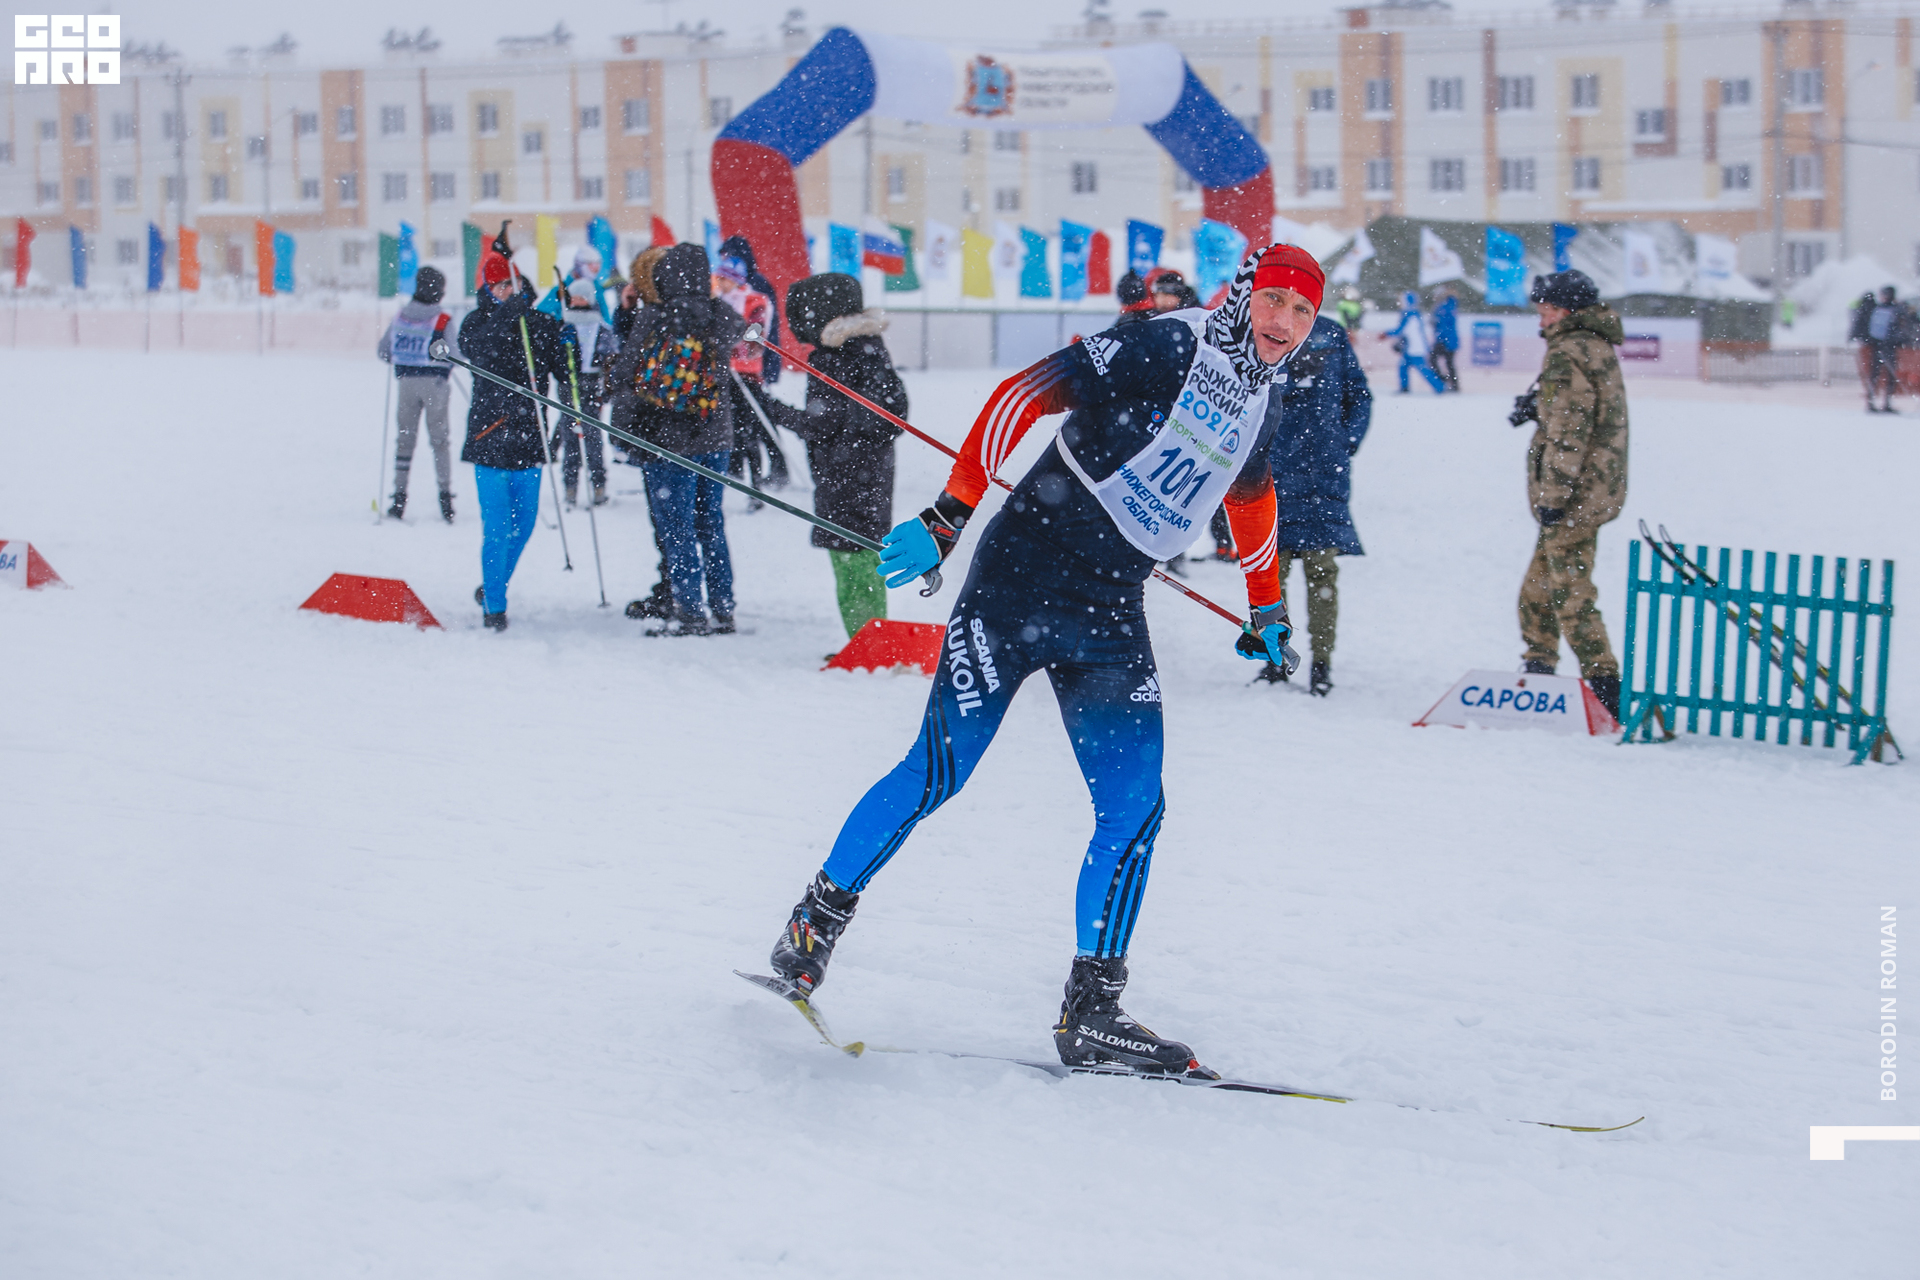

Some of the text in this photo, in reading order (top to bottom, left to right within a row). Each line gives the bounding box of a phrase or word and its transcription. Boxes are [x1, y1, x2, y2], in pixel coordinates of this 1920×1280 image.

[1188, 372, 1243, 420] РОССИИ
[1193, 361, 1249, 404] ЛЫЖНЯ
[1177, 390, 1232, 437] 2021
[947, 615, 983, 718] LUKOIL
[969, 617, 1001, 694] SCANIA
[1461, 685, 1566, 714] САРОВА
[814, 903, 847, 922] SALOMON
[1077, 1024, 1160, 1053] SALOMON
